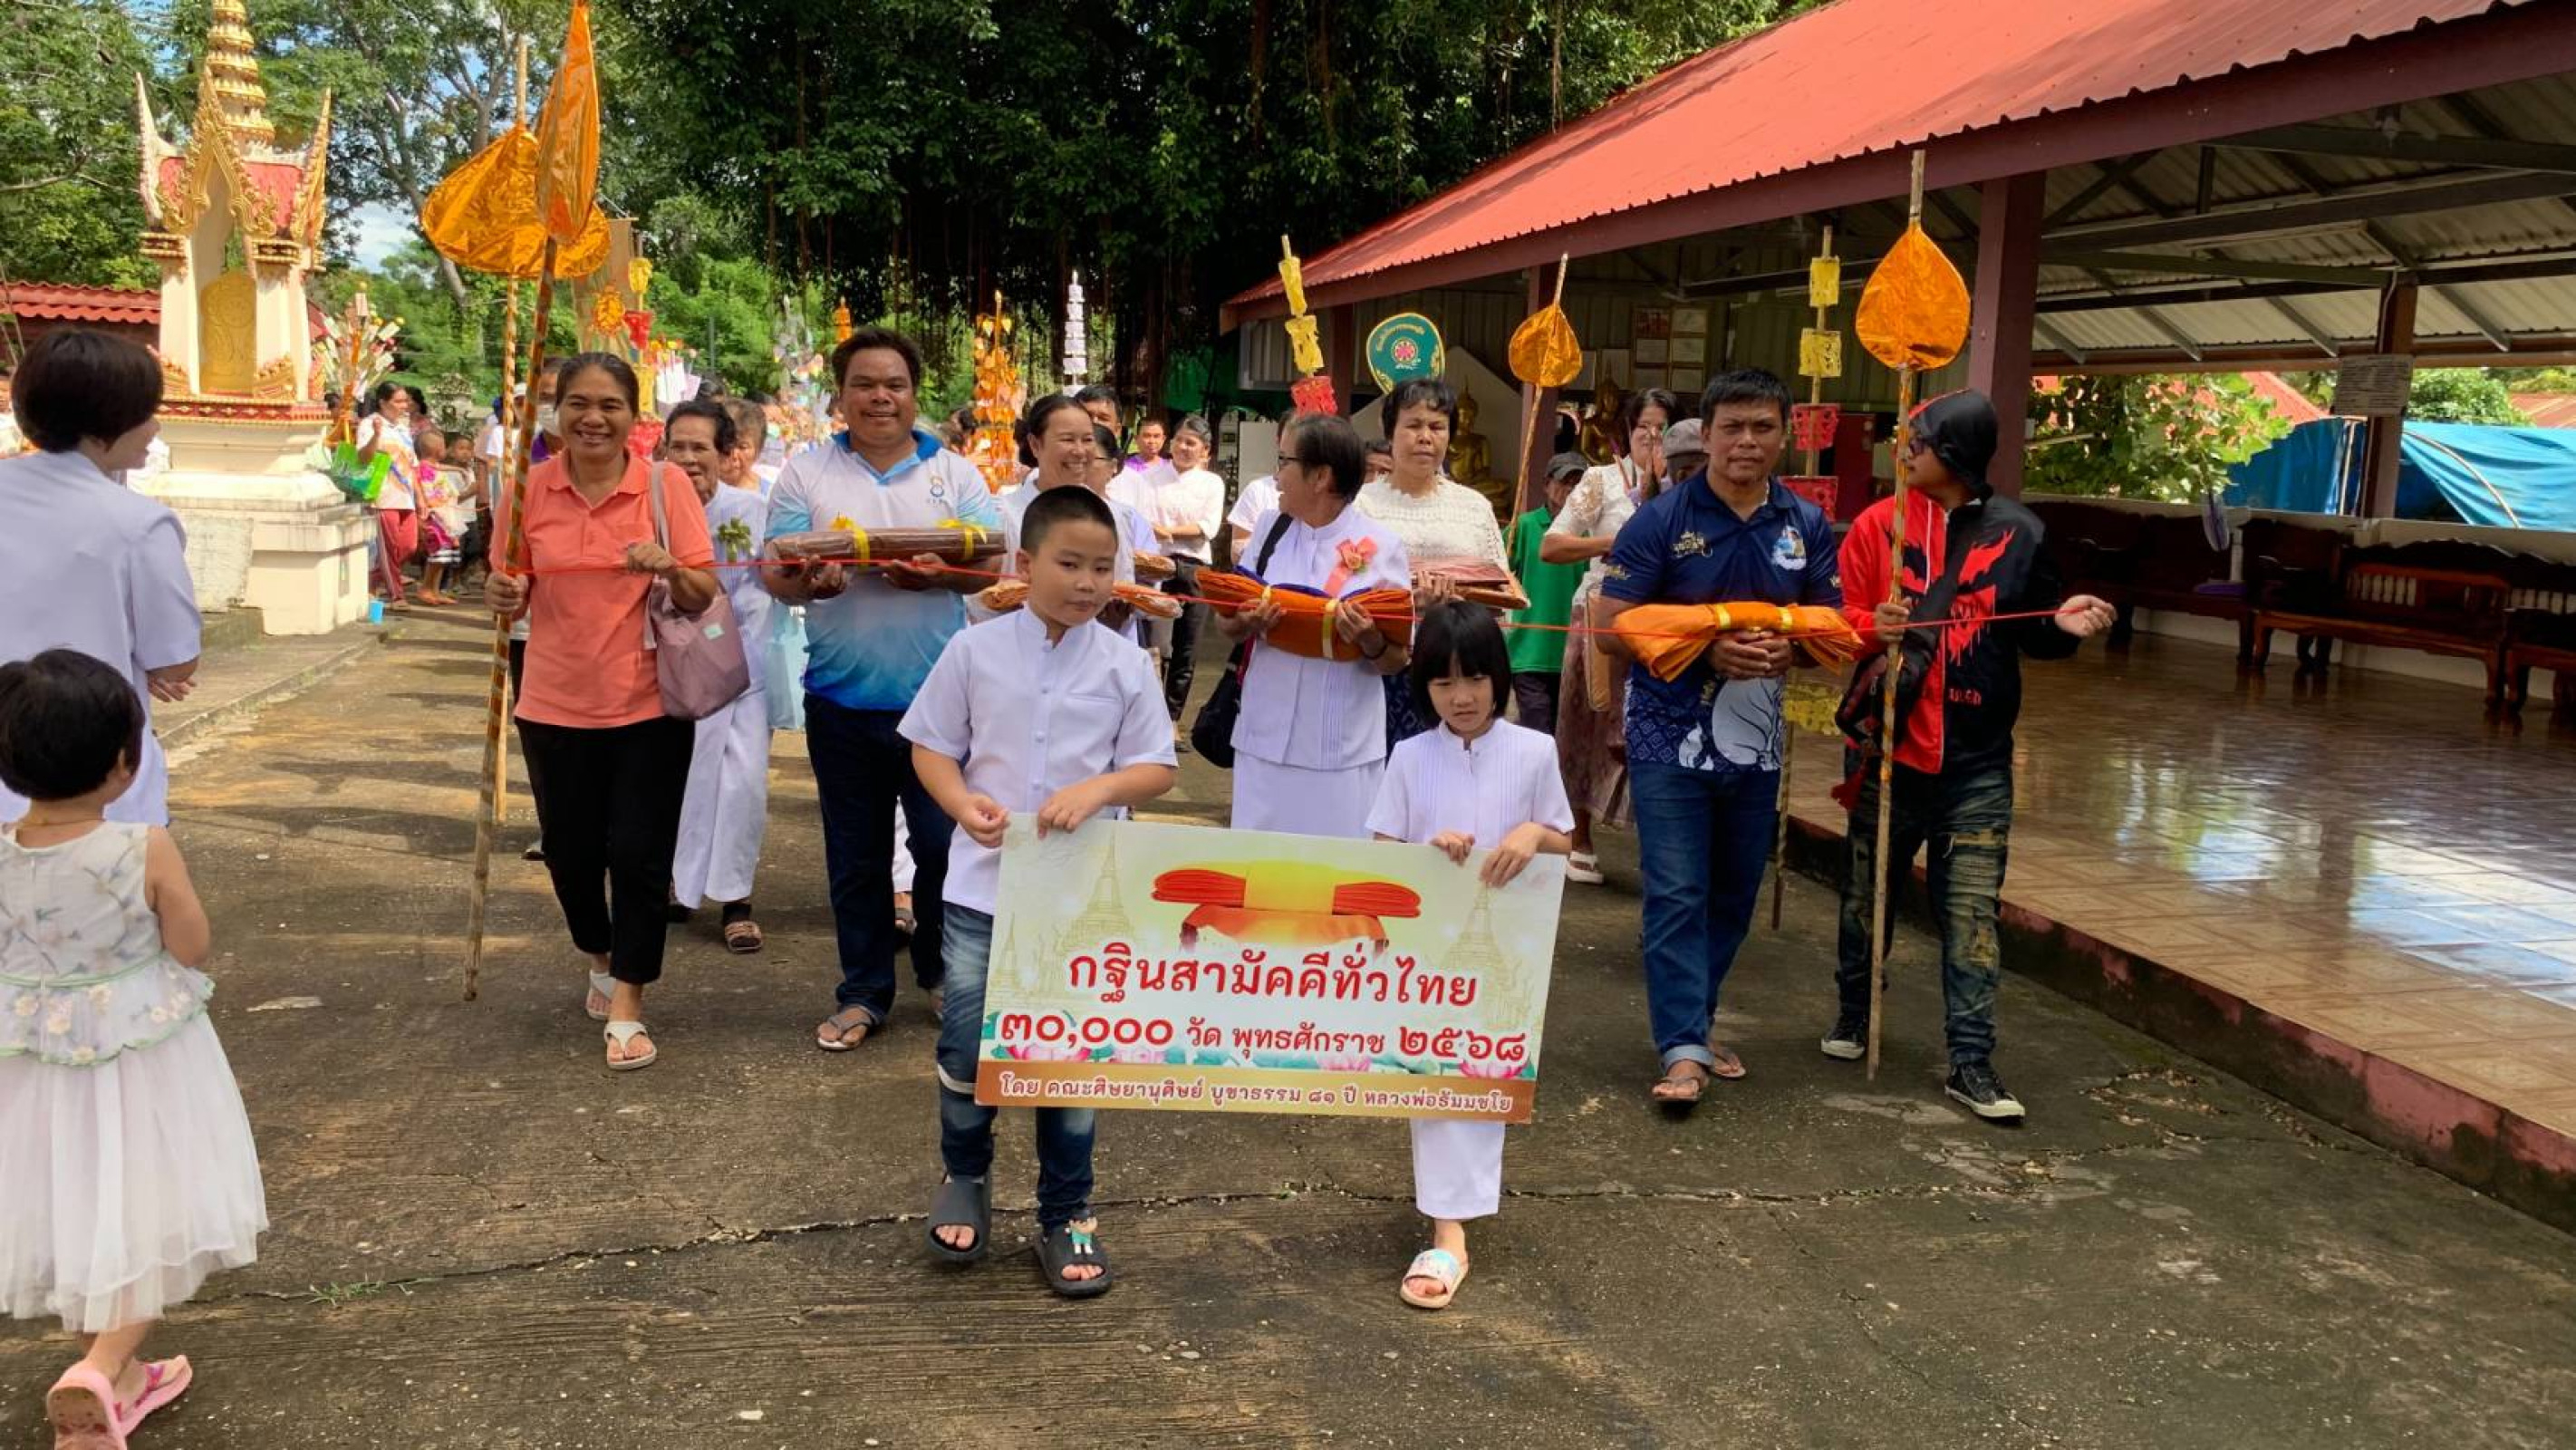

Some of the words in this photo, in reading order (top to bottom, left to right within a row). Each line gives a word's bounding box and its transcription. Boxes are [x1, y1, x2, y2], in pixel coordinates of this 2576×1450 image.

[1069, 942, 1477, 1006] กฐินสามัคคีทั่วไทย
[1001, 1013, 1173, 1049] ๓๐,๐๐๐
[1186, 1016, 1221, 1047] วัด
[1232, 1021, 1385, 1059] พุทธศักราช
[1399, 1026, 1527, 1061] ๒๕๖๘
[1001, 1073, 1039, 1097] โดย
[1047, 1076, 1205, 1105] คณะศิษยานุศิษย์
[1344, 1085, 1356, 1105] ปี
